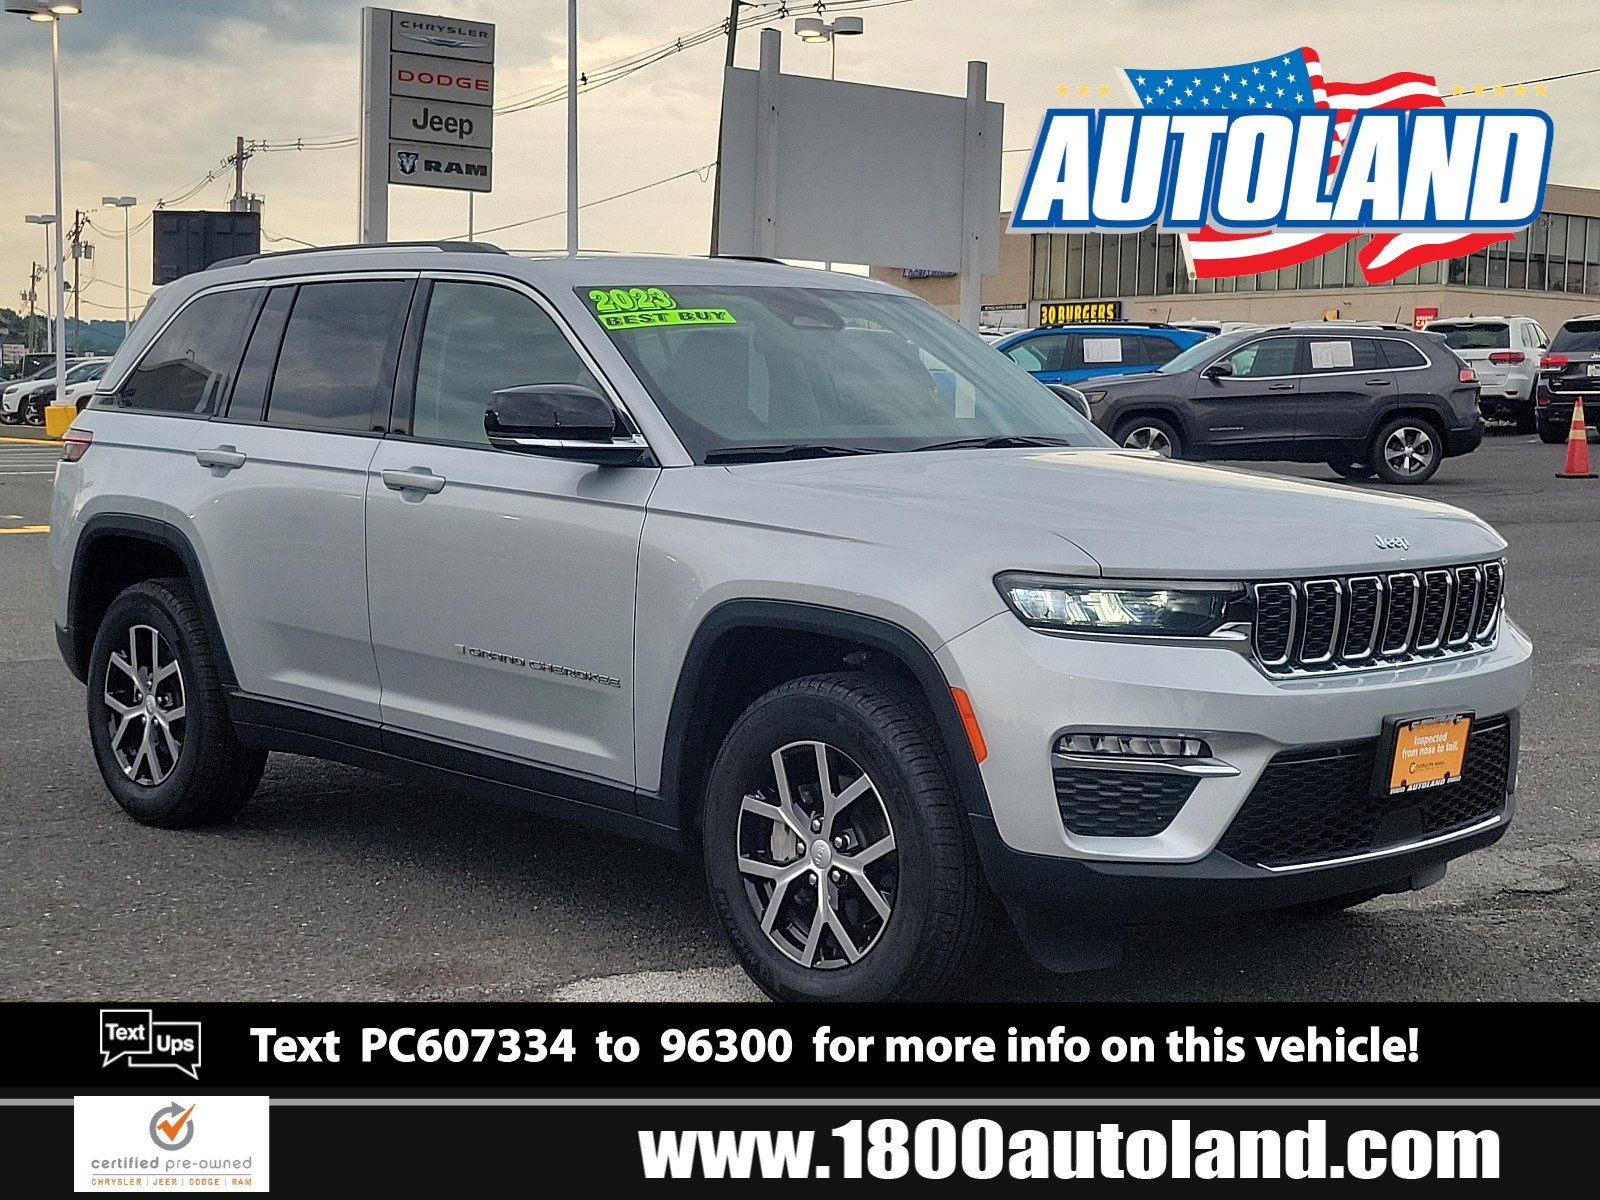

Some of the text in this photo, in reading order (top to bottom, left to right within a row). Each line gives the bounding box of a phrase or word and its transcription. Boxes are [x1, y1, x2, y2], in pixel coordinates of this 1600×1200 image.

[400, 20, 488, 39] CHRYSLER
[397, 69, 490, 92] DODGE
[412, 107, 474, 140] Jeep
[424, 159, 488, 177] RAM
[588, 287, 677, 313] 2023
[605, 311, 726, 327] BEST BUY
[1041, 303, 1114, 325] 30 BURGERS
[1375, 534, 1409, 550] Jeep
[469, 647, 621, 688] GRAND CHEROKEE
[1414, 732, 1448, 746] Inspected
[1402, 747, 1418, 759] from
[1419, 747, 1436, 755] nose
[1436, 743, 1445, 752] to
[1407, 780, 1446, 791] AUTOLAND
